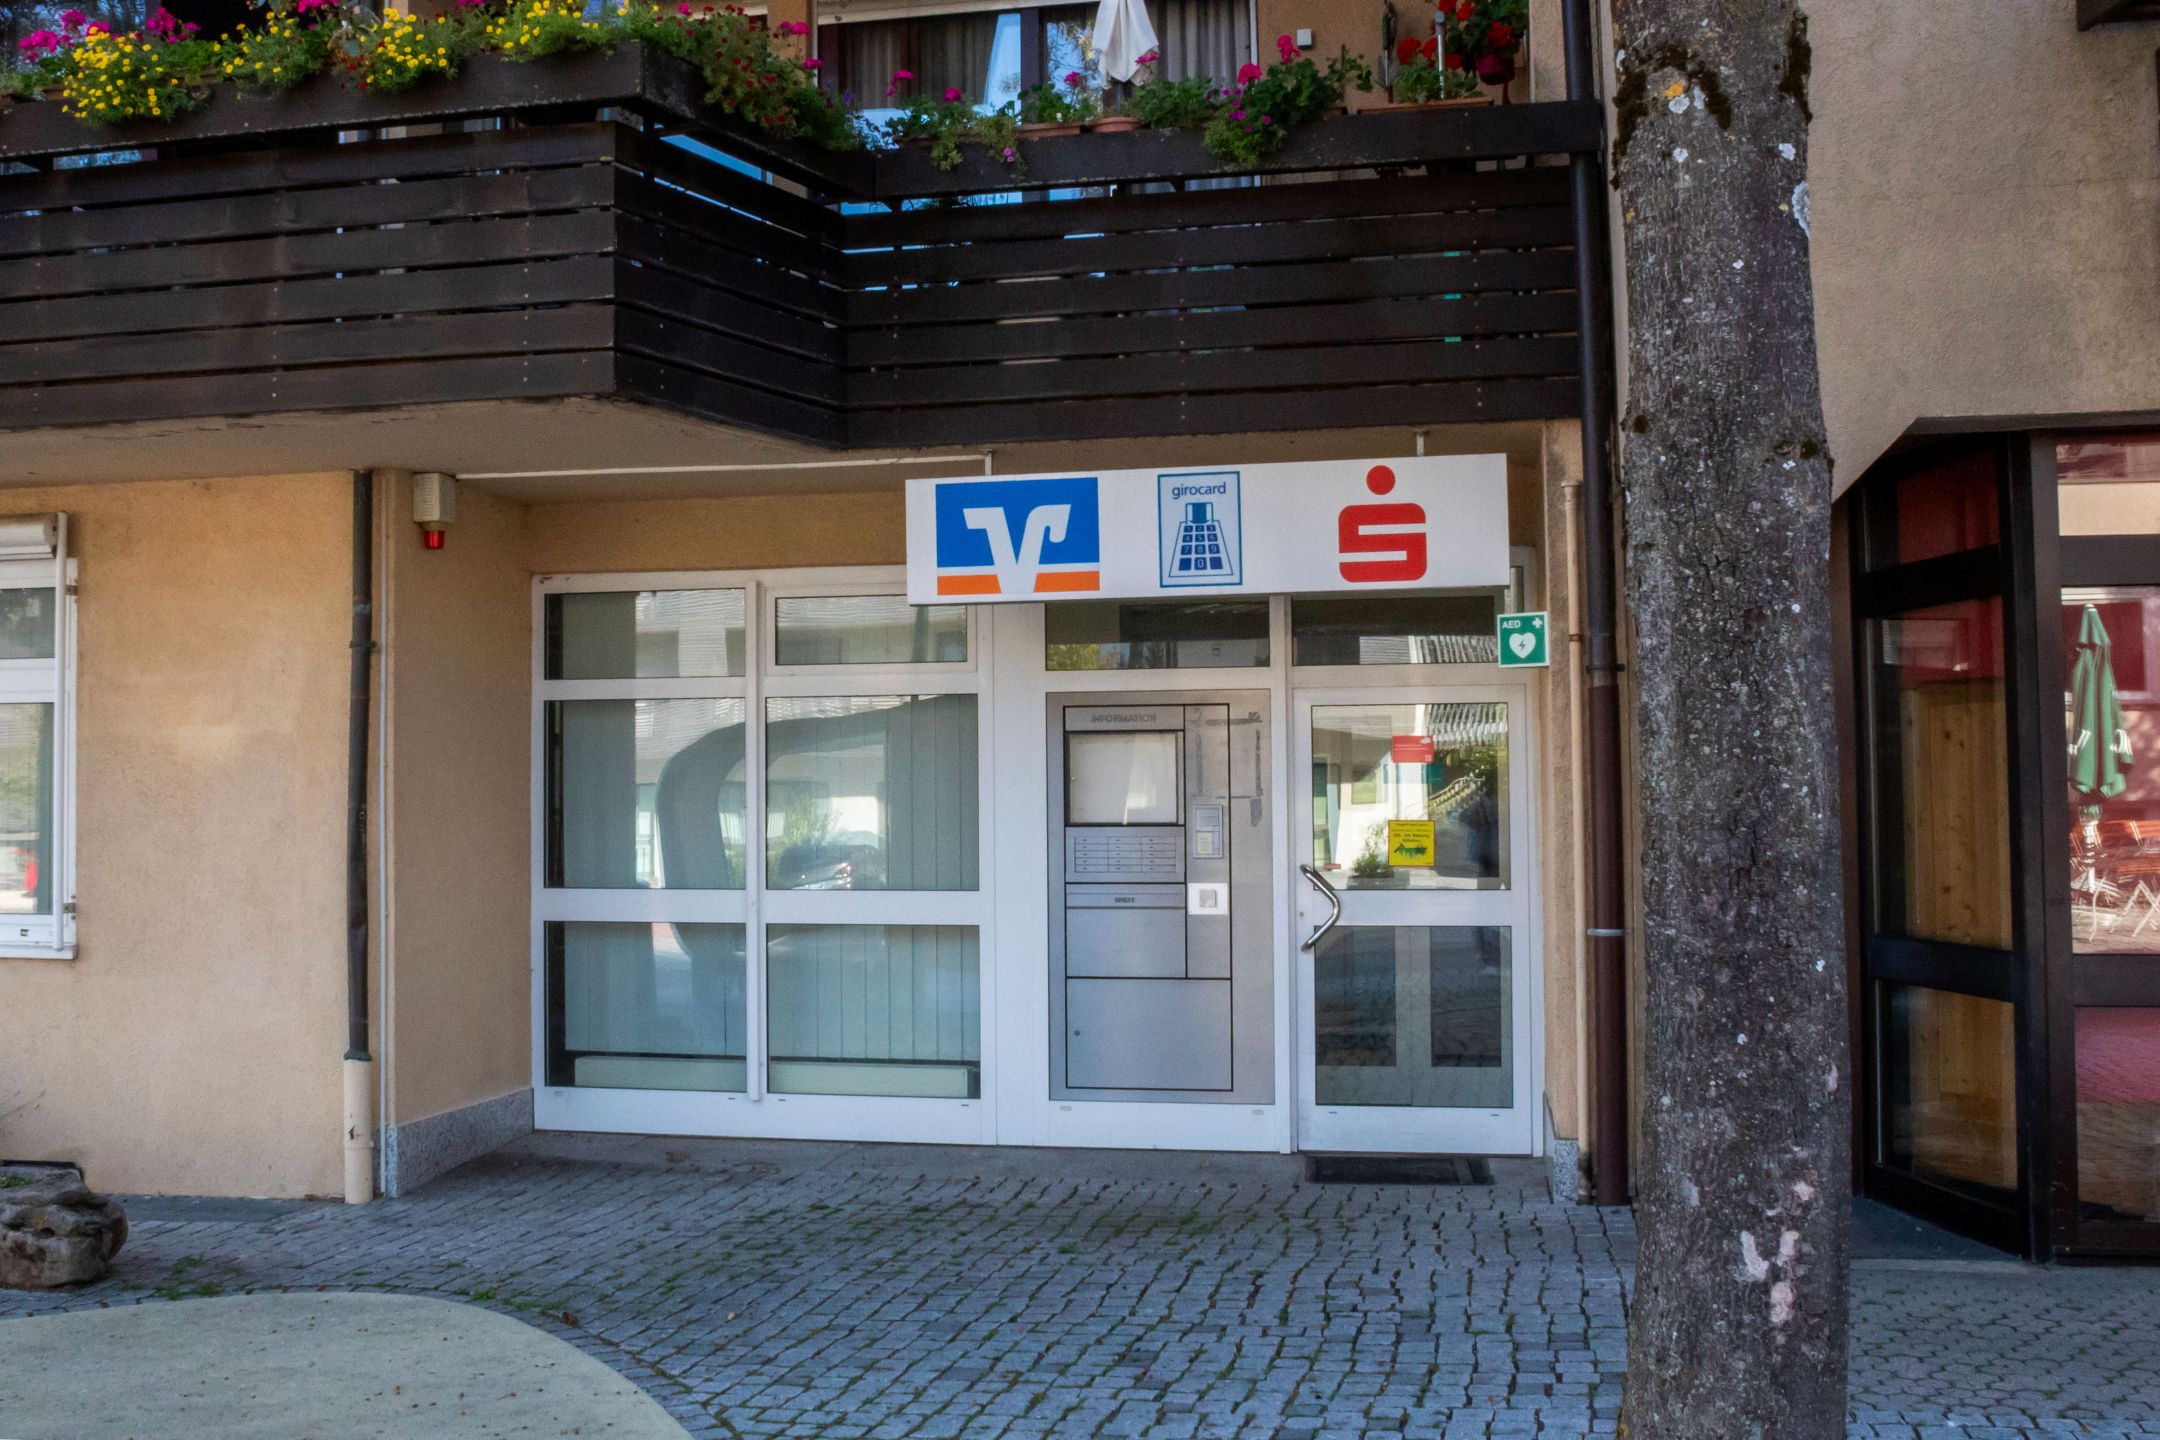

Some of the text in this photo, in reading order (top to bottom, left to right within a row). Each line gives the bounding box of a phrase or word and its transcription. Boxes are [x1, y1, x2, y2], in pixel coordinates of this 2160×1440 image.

[1172, 481, 1226, 500] girocard
[1197, 559, 1204, 569] 0
[1502, 619, 1521, 629] AED
[1091, 713, 1157, 723] INFORMATION
